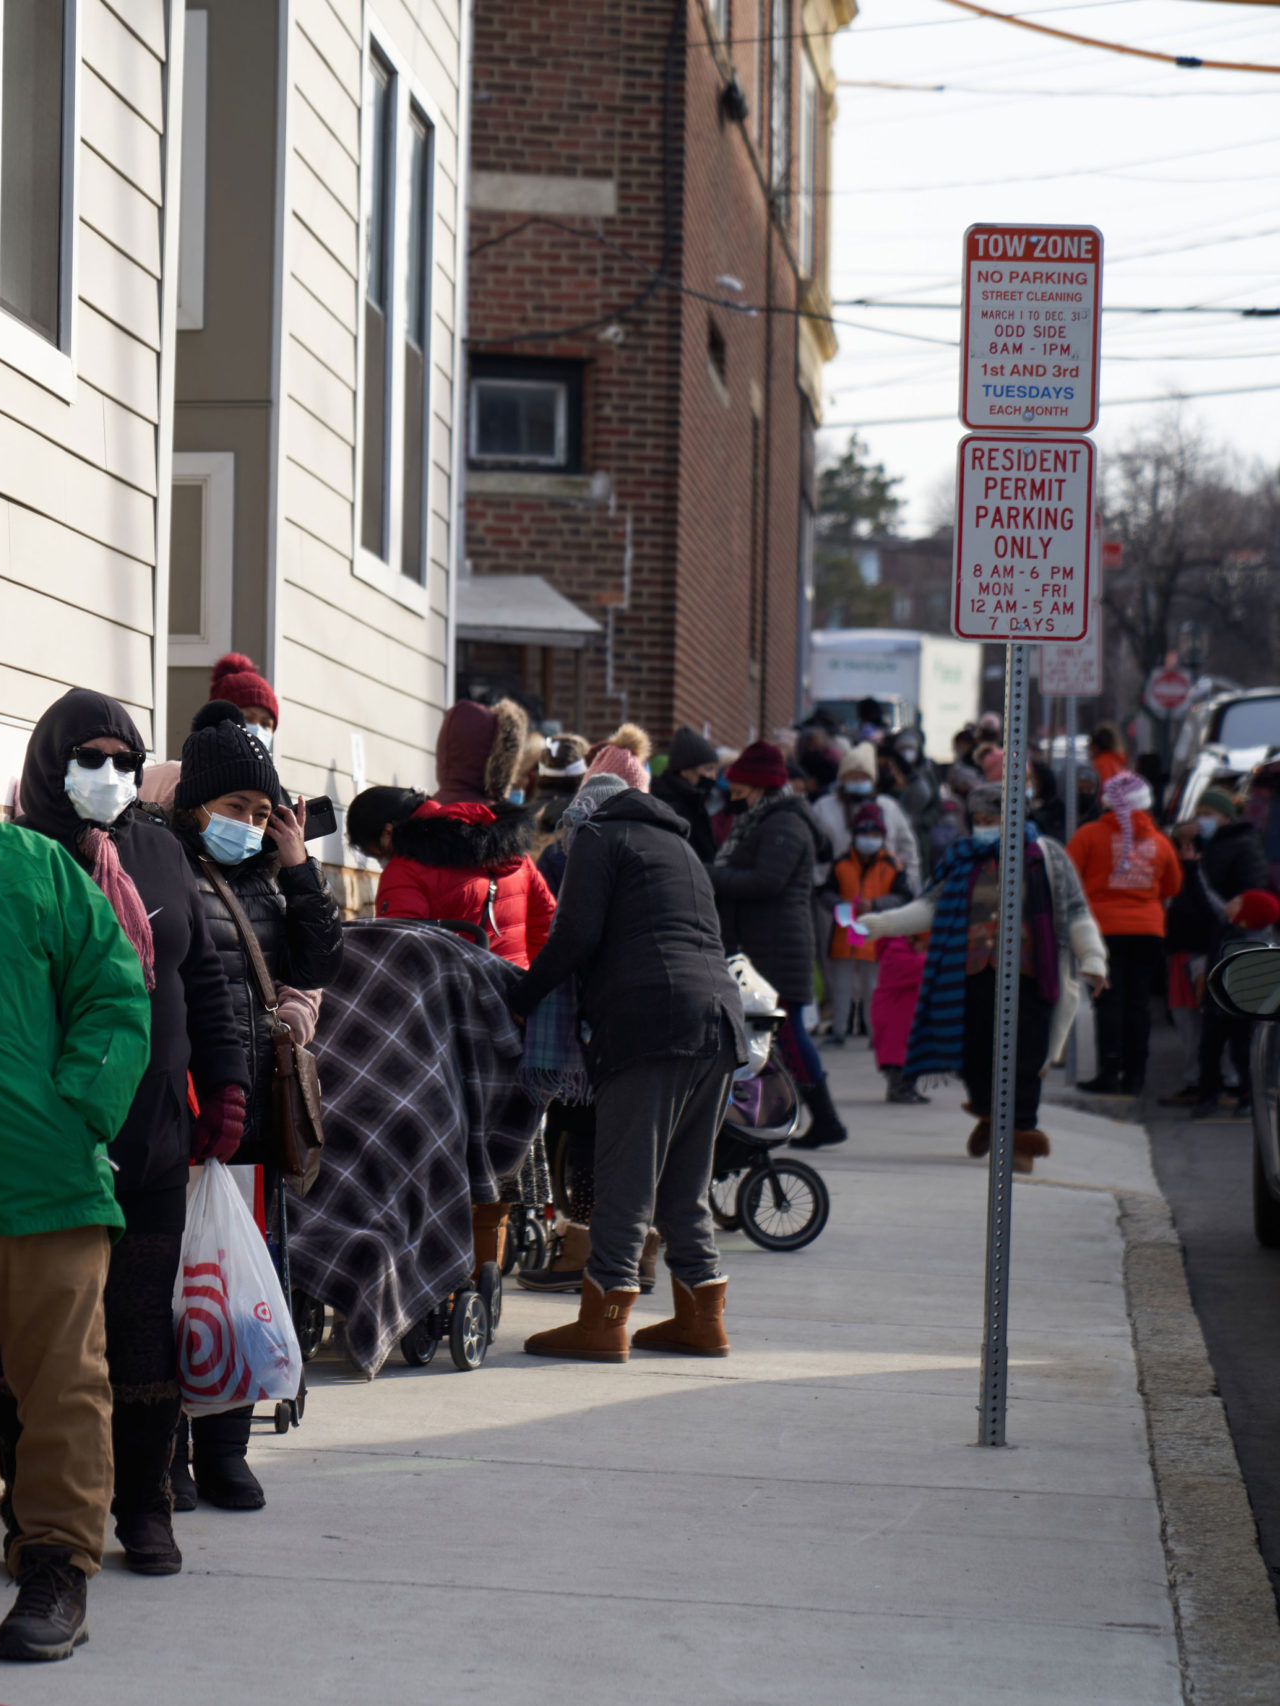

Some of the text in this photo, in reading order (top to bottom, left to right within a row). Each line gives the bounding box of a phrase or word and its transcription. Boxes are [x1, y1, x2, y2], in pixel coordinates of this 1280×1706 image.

[975, 234, 1093, 259] TOW ZONE
[977, 270, 1088, 285] NO PARKING
[982, 291, 1082, 302] STREET CLEANING
[981, 310, 1015, 320] MARCH
[1028, 311, 1040, 320] TO
[1045, 312, 1066, 321] DEC.
[1071, 312, 1081, 322] 31
[994, 325, 1067, 338] ODD SIDE
[989, 343, 1023, 355] 8AM
[1042, 343, 1071, 356] 1PM
[981, 363, 1079, 378] 1st AND 3rd
[983, 384, 1074, 400] TUESDAYS
[989, 405, 1068, 416] EACH MONTH
[971, 447, 1081, 473] RESIDENT
[984, 477, 1066, 501] PERMIT
[976, 506, 1074, 531] PARKING
[994, 535, 1052, 559] ONLY
[973, 564, 983, 578] 8
[1051, 566, 1074, 580] PM
[979, 582, 1013, 596] MON
[1042, 584, 1067, 597] FRI
[971, 599, 985, 612] 12
[1050, 602, 1074, 615] AM
[989, 617, 1055, 632] 7 DAYS
